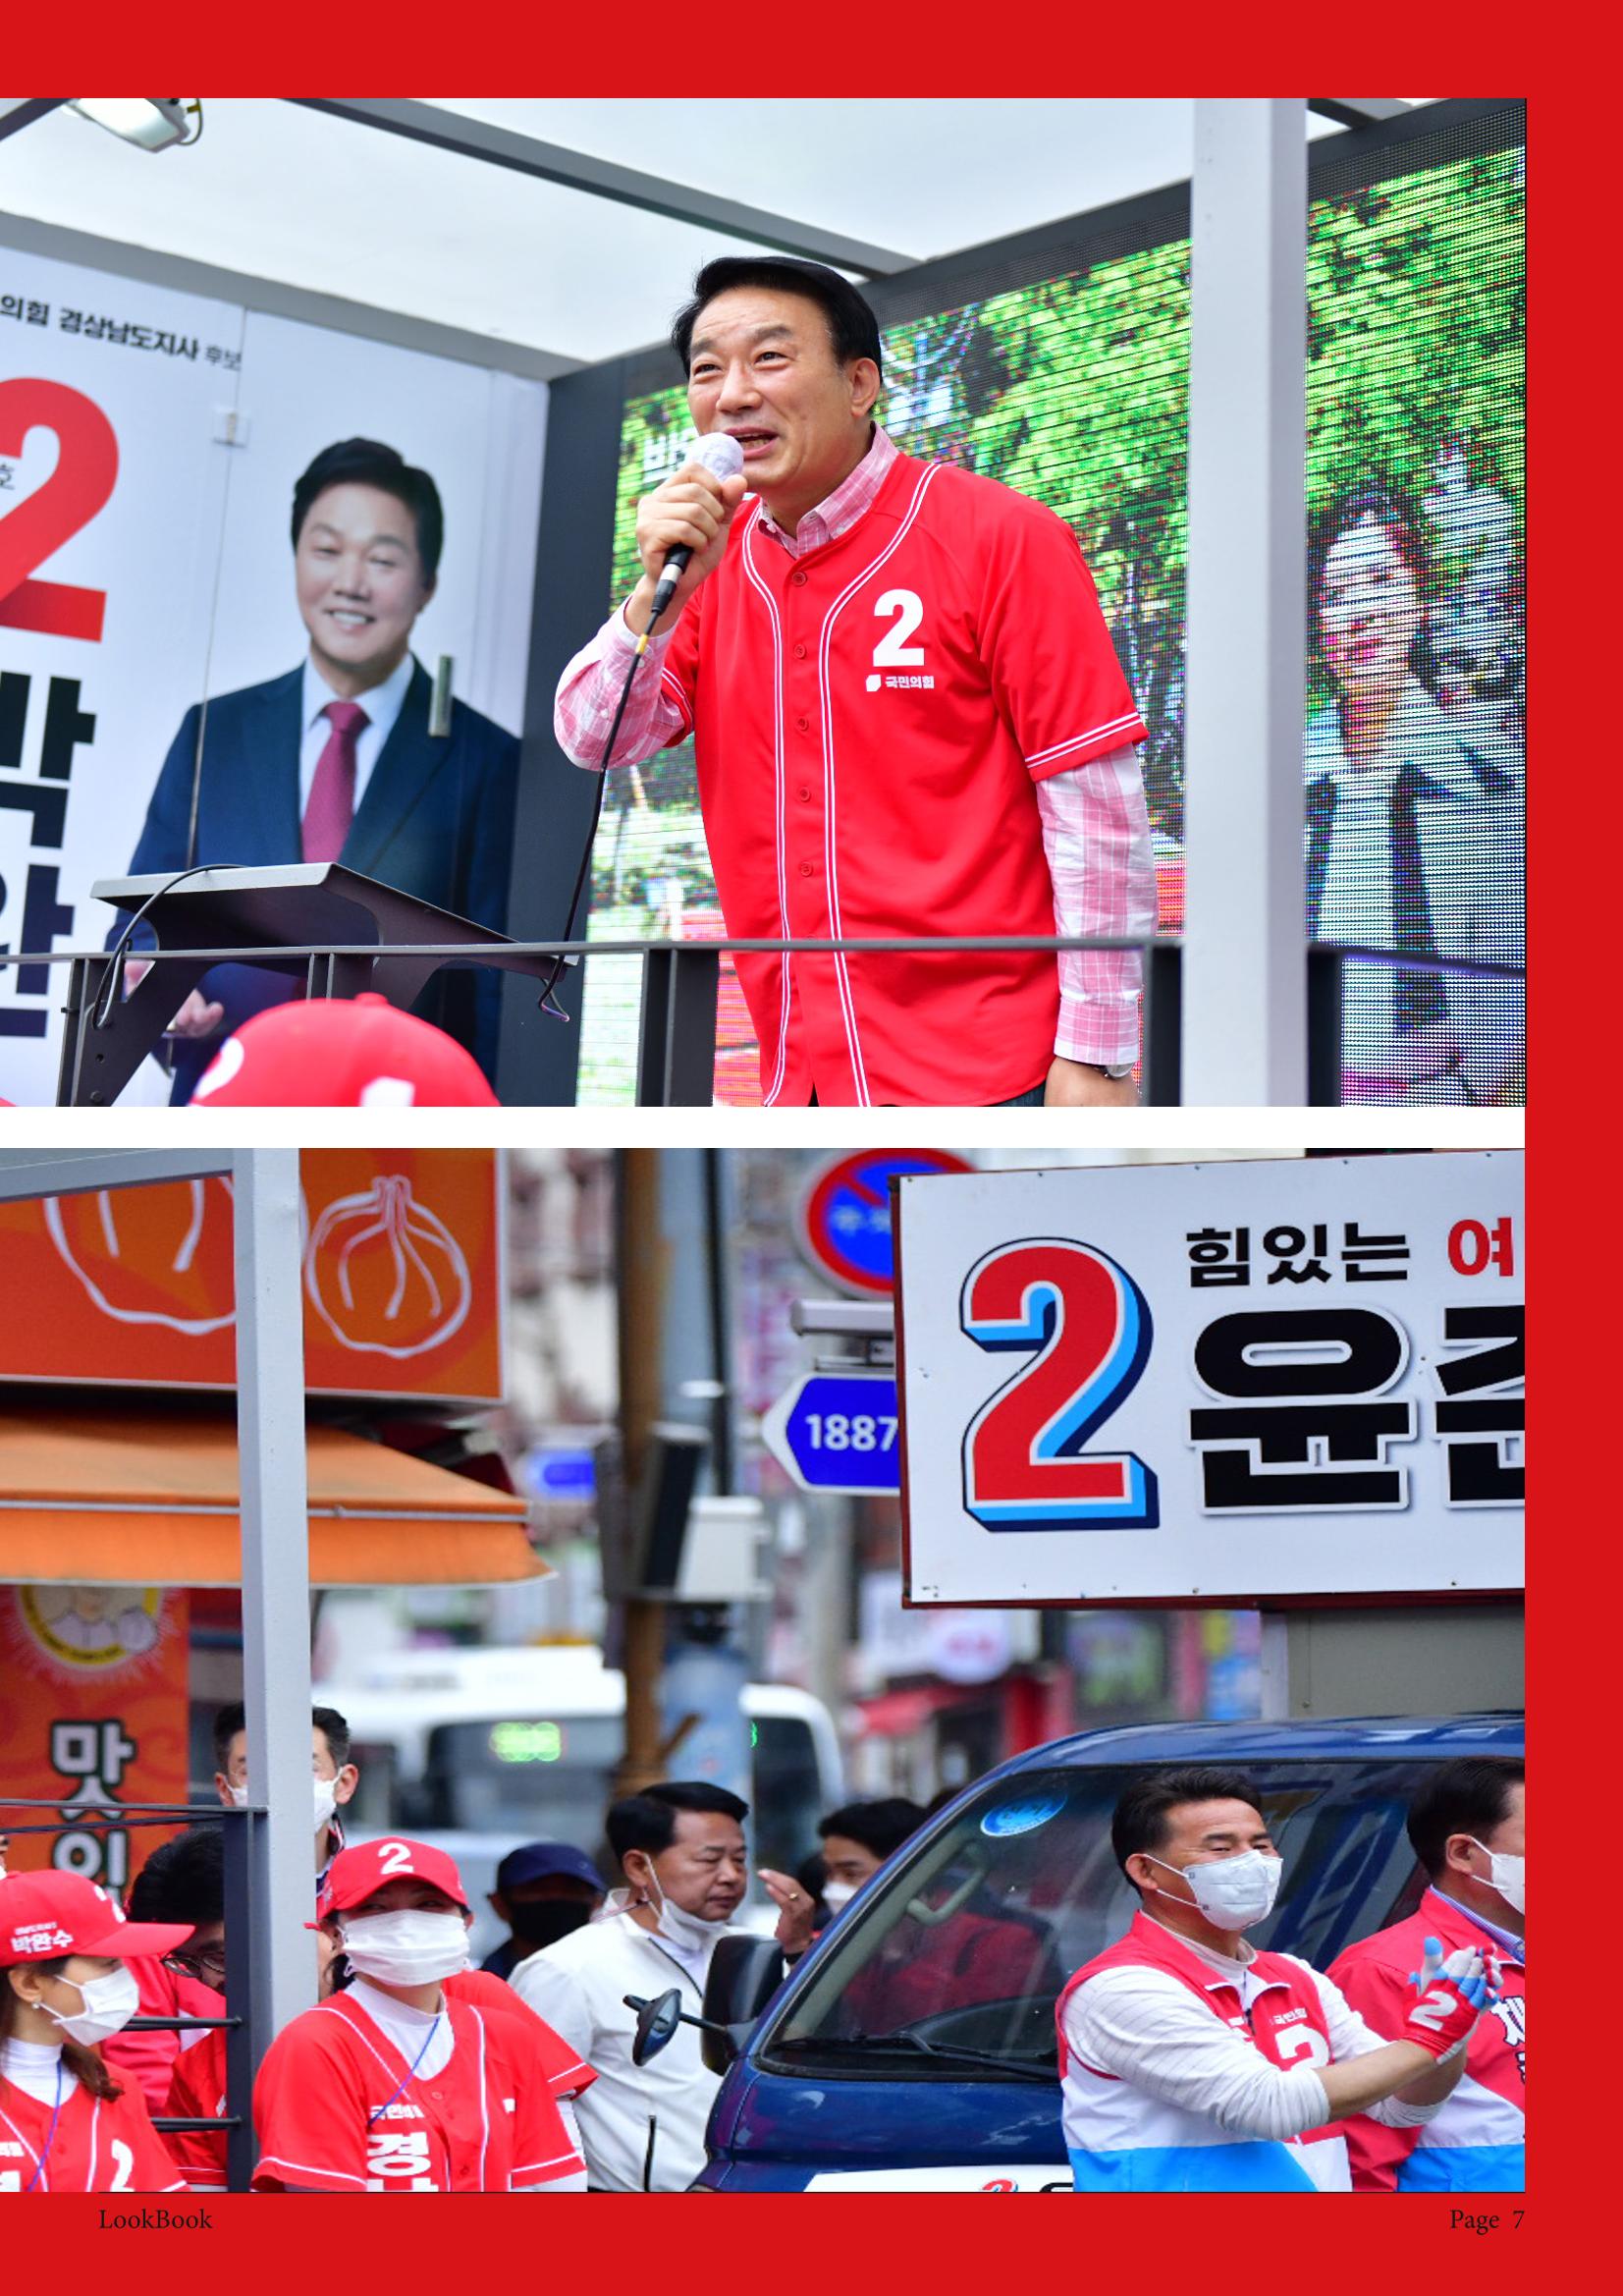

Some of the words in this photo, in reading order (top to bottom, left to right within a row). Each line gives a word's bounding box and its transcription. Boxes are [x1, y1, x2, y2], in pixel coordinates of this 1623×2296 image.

[60, 307, 198, 361] 경상남도지사
[205, 345, 242, 372] 후보
[0, 377, 119, 643] 2
[873, 588, 925, 667] 2
[885, 675, 935, 689] 국민의힘
[1186, 1223, 1410, 1287] 힘있는
[1447, 1217, 1514, 1277] 여
[960, 1236, 1160, 1532] 2
[805, 1413, 898, 1451] 1887
[377, 1842, 414, 1875] 2
[10, 1929, 74, 1954] 박완수
[1409, 1990, 1458, 2032] 2
